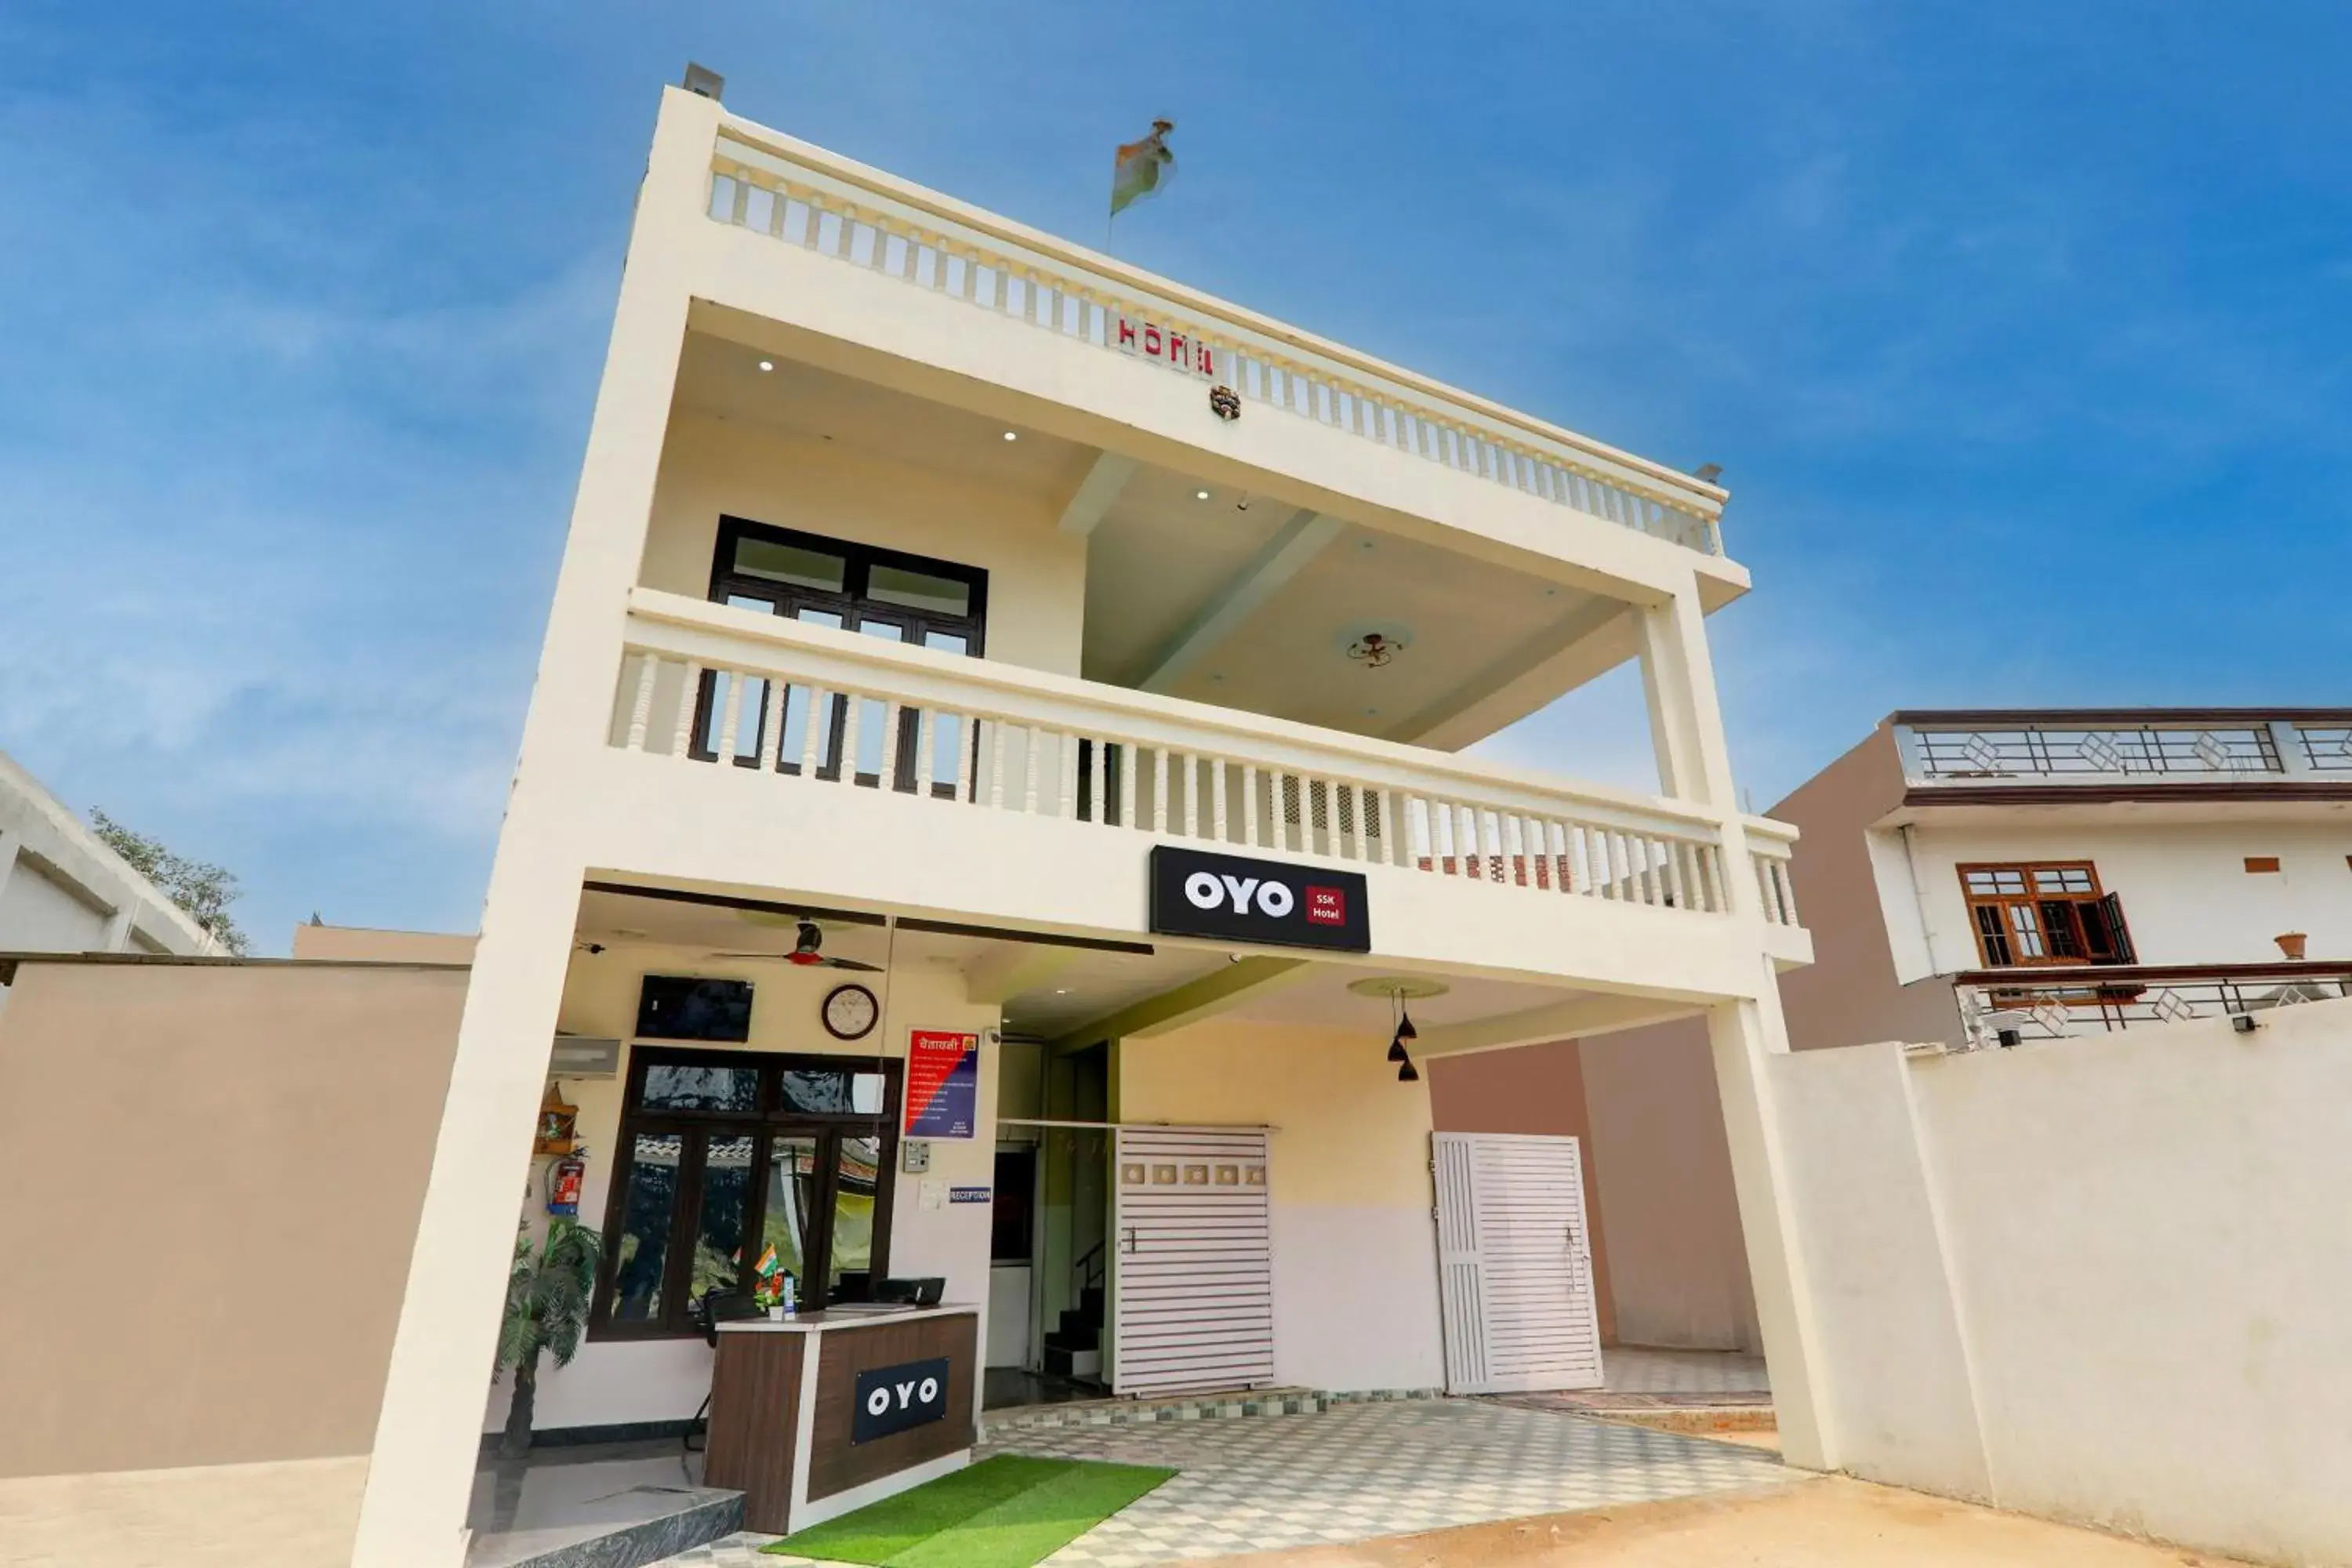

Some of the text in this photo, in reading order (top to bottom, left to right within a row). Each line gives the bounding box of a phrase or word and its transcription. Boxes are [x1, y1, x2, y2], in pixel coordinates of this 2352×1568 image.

[1185, 871, 1294, 918] OYO
[1316, 894, 1336, 906] SSK
[1313, 907, 1339, 919] Hotel
[950, 1191, 991, 1201] RECEPTION
[867, 1377, 938, 1416] OYO
